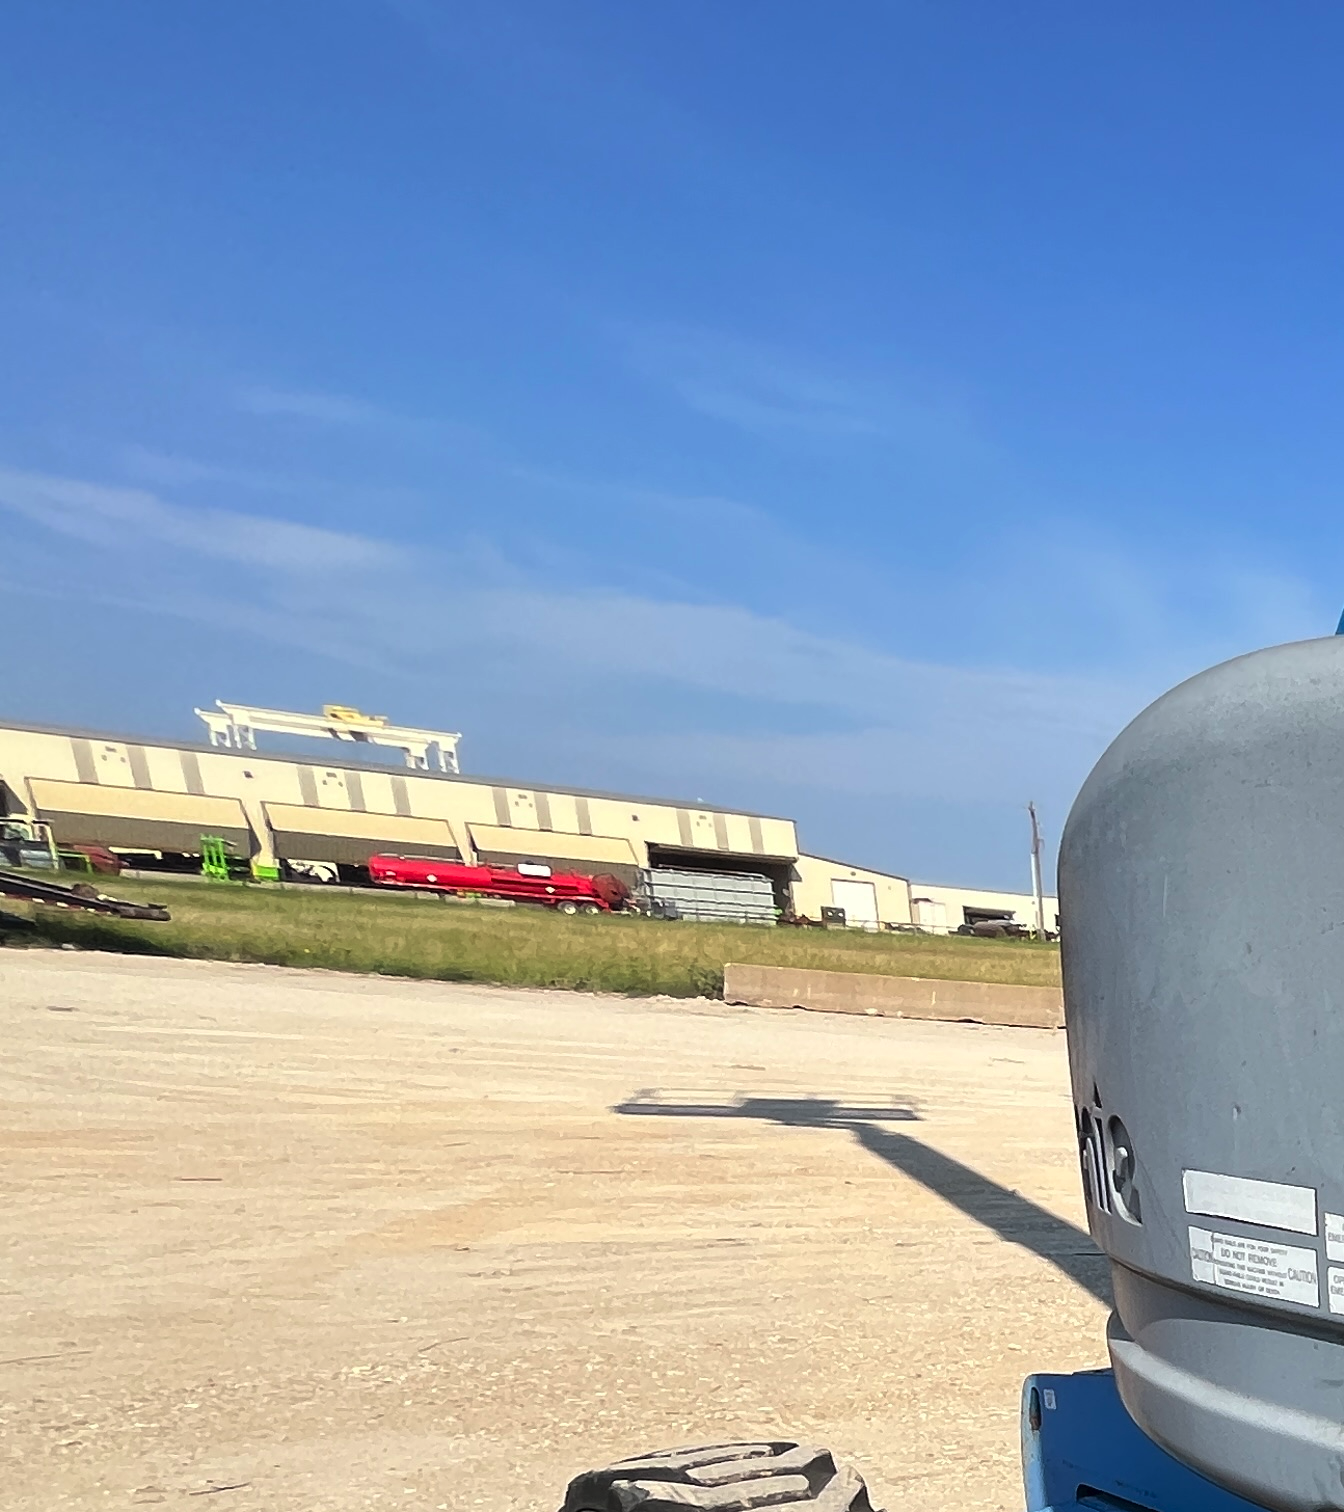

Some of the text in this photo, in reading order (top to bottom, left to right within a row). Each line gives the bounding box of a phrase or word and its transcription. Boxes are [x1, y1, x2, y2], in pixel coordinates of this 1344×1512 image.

[1220, 1247, 1278, 1267] DO NOT REMOVE
[1287, 1267, 1317, 1284] CAUTION
